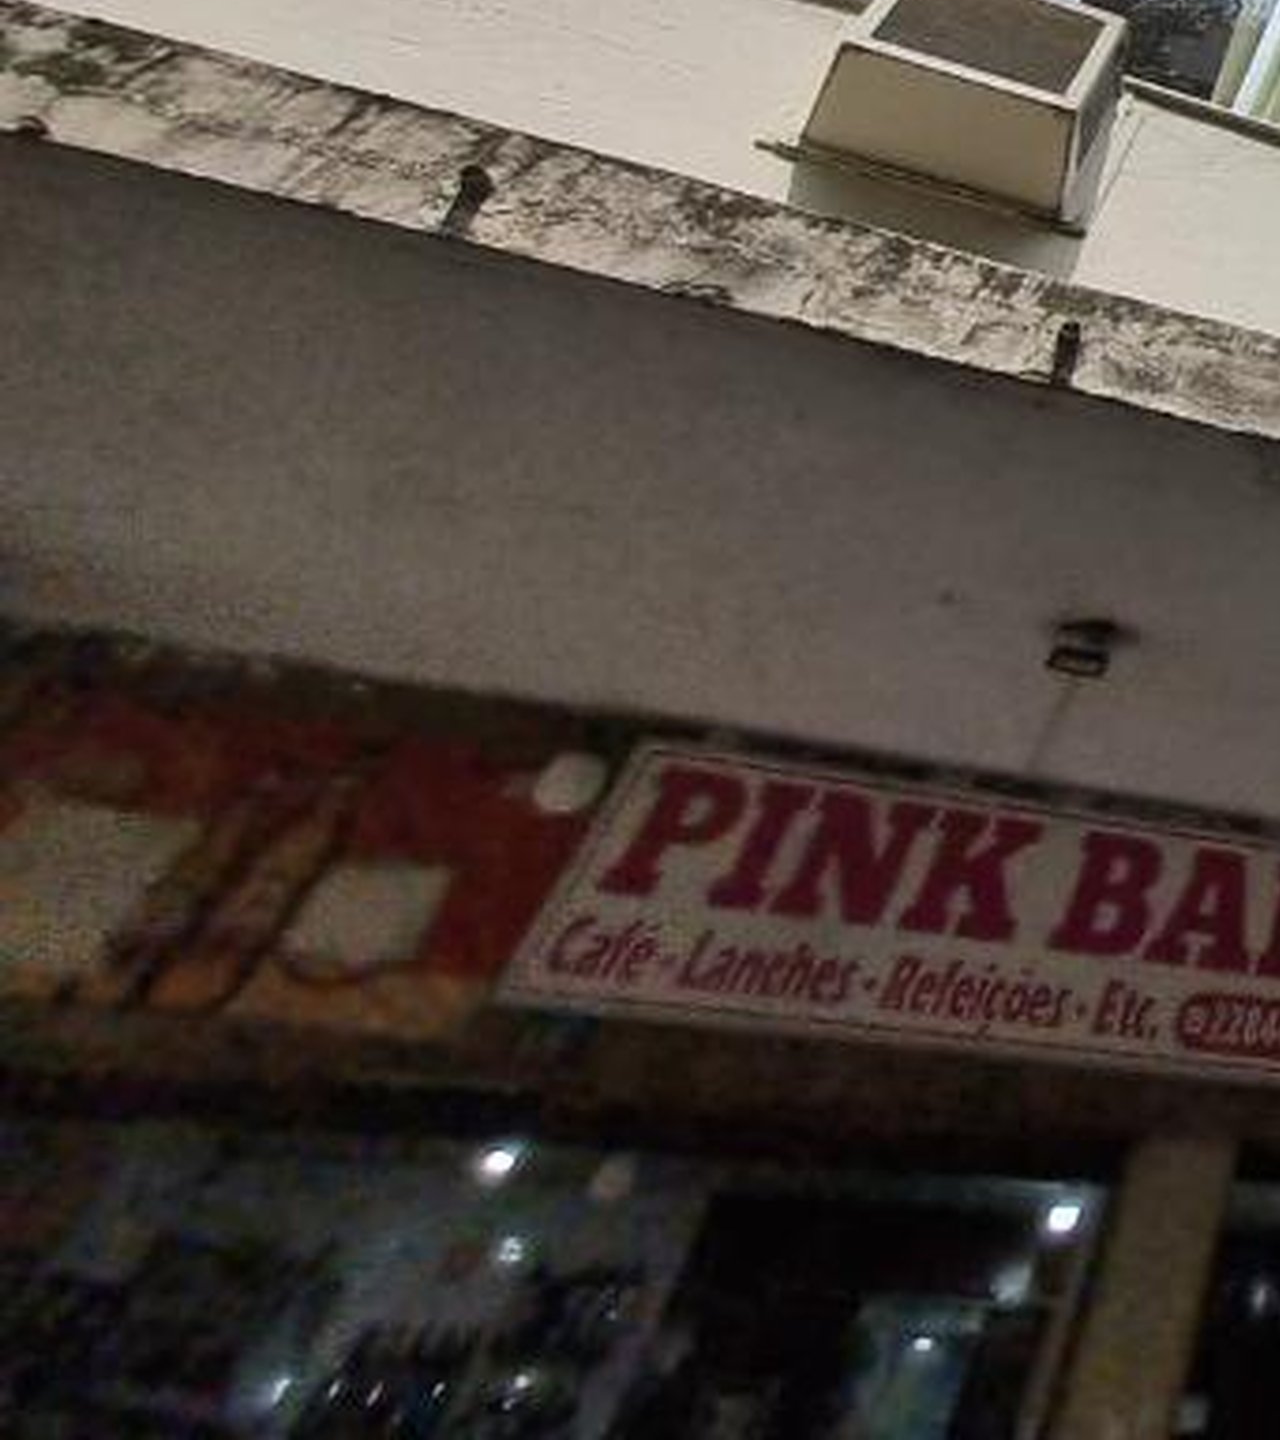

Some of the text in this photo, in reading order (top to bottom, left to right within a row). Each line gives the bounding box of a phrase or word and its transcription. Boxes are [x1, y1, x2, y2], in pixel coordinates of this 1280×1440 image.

[602, 765, 1042, 940] PINK
[546, 915, 660, 982] Café
[676, 929, 858, 1002] Lanches
[878, 954, 1071, 1035] Refeições
[1091, 978, 1161, 1039] Etc.
